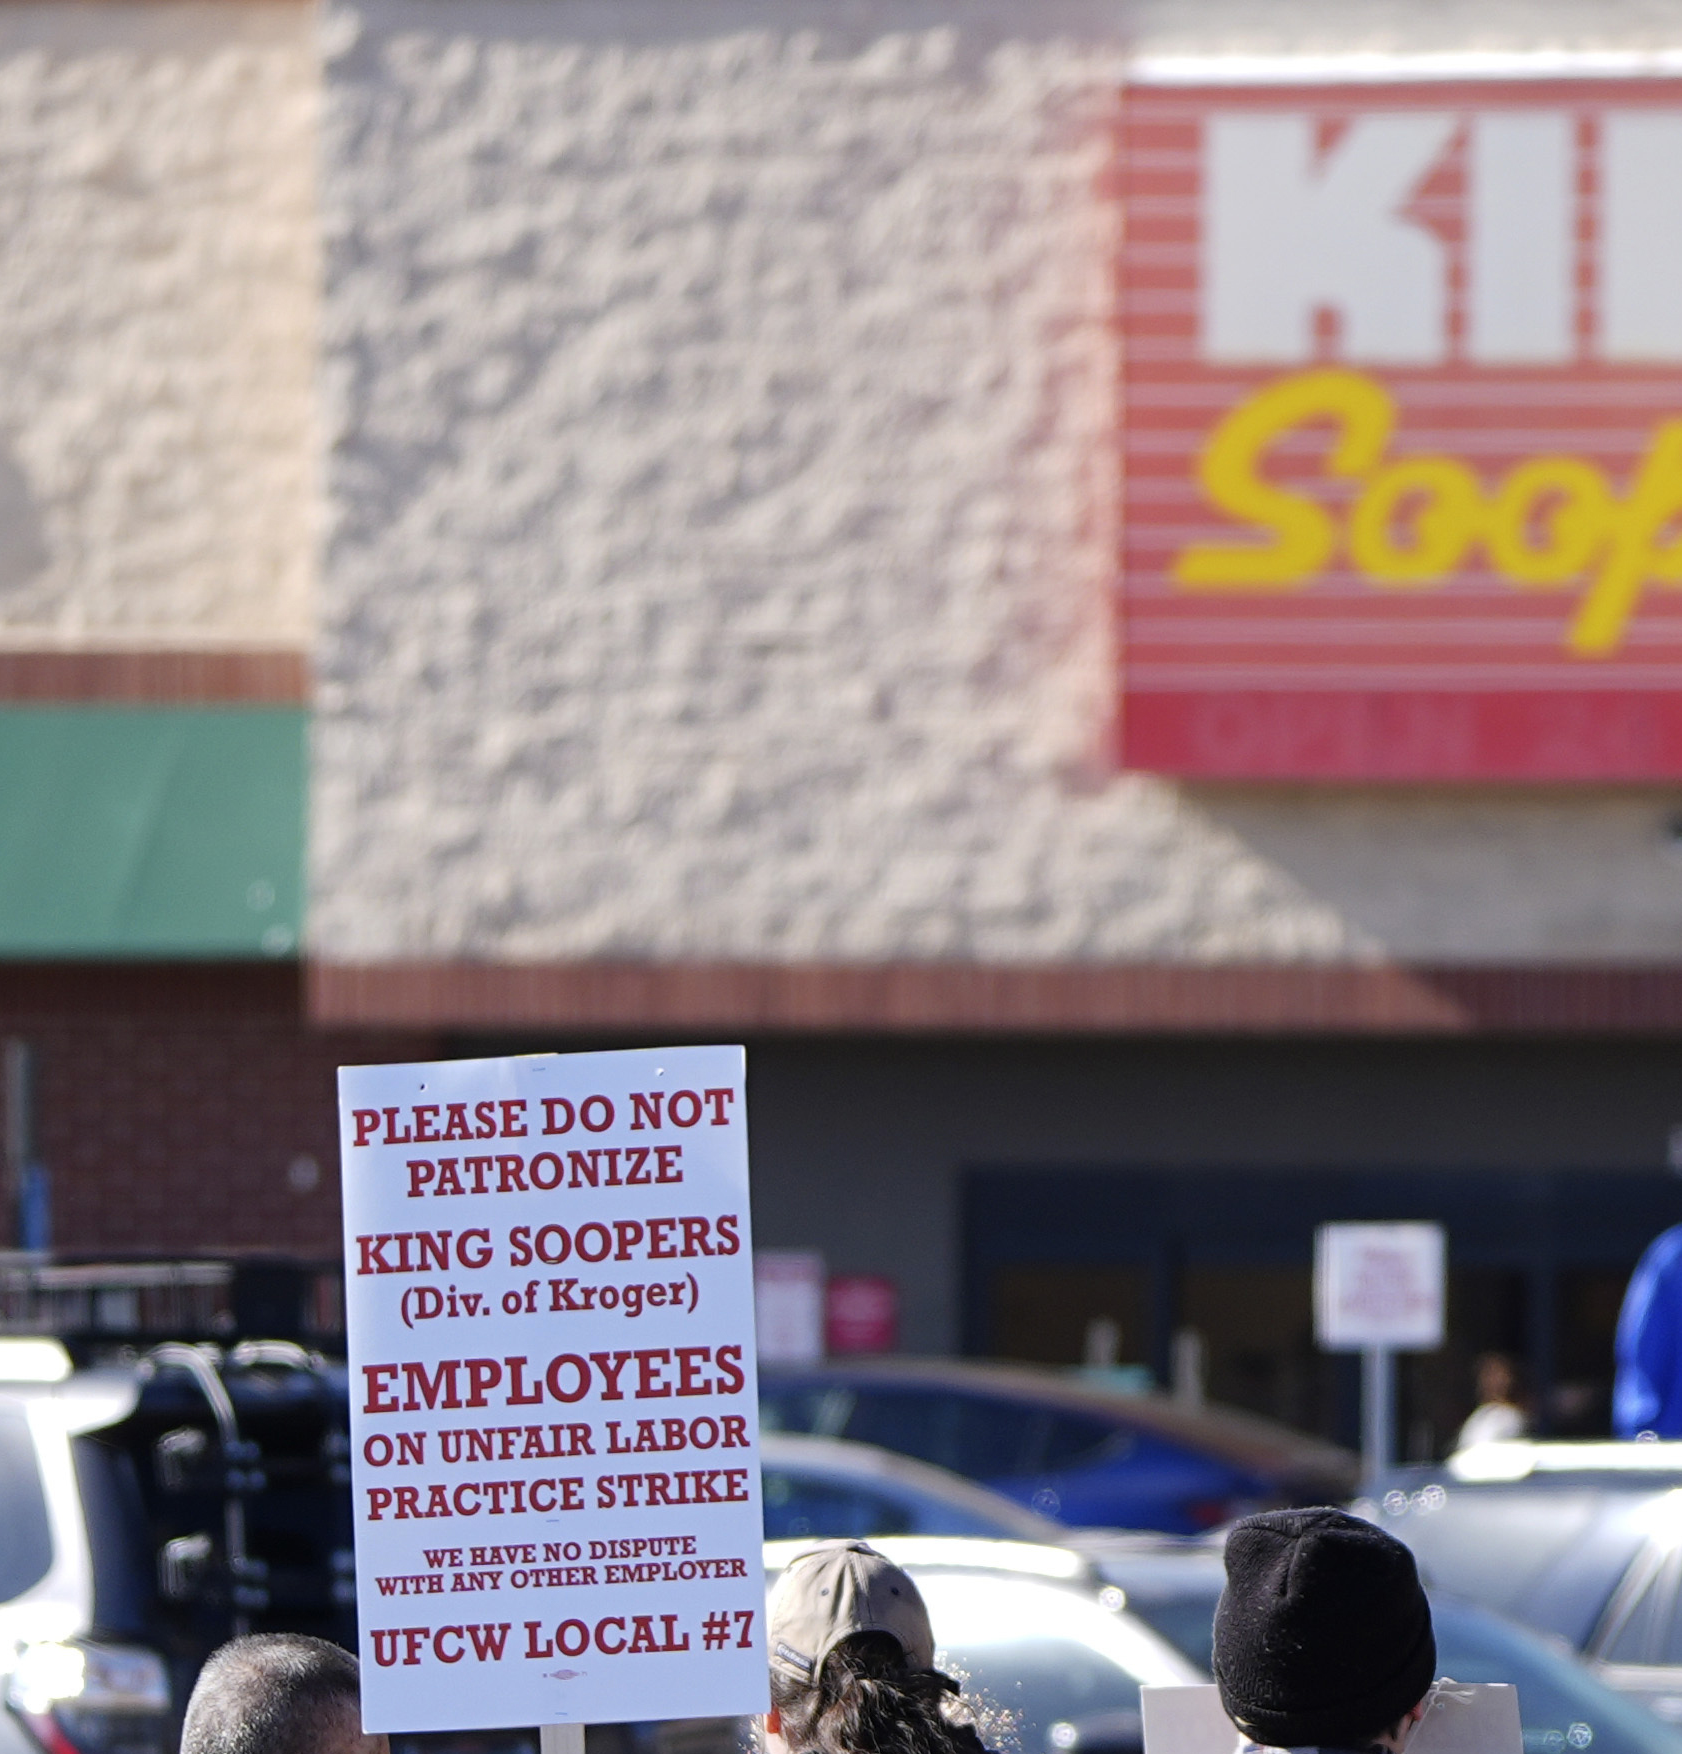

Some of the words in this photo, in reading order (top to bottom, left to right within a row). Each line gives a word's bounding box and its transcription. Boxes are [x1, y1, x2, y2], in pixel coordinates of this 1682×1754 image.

[352, 1103, 527, 1147] PLEASE
[542, 1096, 615, 1135] DO
[630, 1088, 734, 1130] NOT
[407, 1146, 683, 1197] PATRONIZE
[356, 1230, 493, 1275] KING
[510, 1216, 740, 1266] SOOPERS
[401, 1286, 490, 1327] (Div.
[503, 1281, 540, 1314] of
[549, 1274, 698, 1317] Kroger)
[362, 1346, 744, 1414] EMPLOYEES
[364, 1432, 427, 1467] ON
[439, 1424, 595, 1463] UNFAIR
[607, 1416, 750, 1454] LABOR
[367, 1478, 584, 1520] PRACTICE
[597, 1469, 748, 1508] STRIKE
[377, 1575, 444, 1595] WITH
[452, 1571, 503, 1592] ANY
[511, 1567, 597, 1588] OTHER
[605, 1559, 747, 1584] EMPLOYER
[423, 1548, 462, 1568] WE
[471, 1545, 536, 1566] HAVE
[544, 1542, 581, 1562] NO
[589, 1536, 695, 1560] DISPUTE
[371, 1623, 511, 1666] UFCW
[524, 1615, 689, 1658] LOCAL
[703, 1611, 753, 1650] #7
